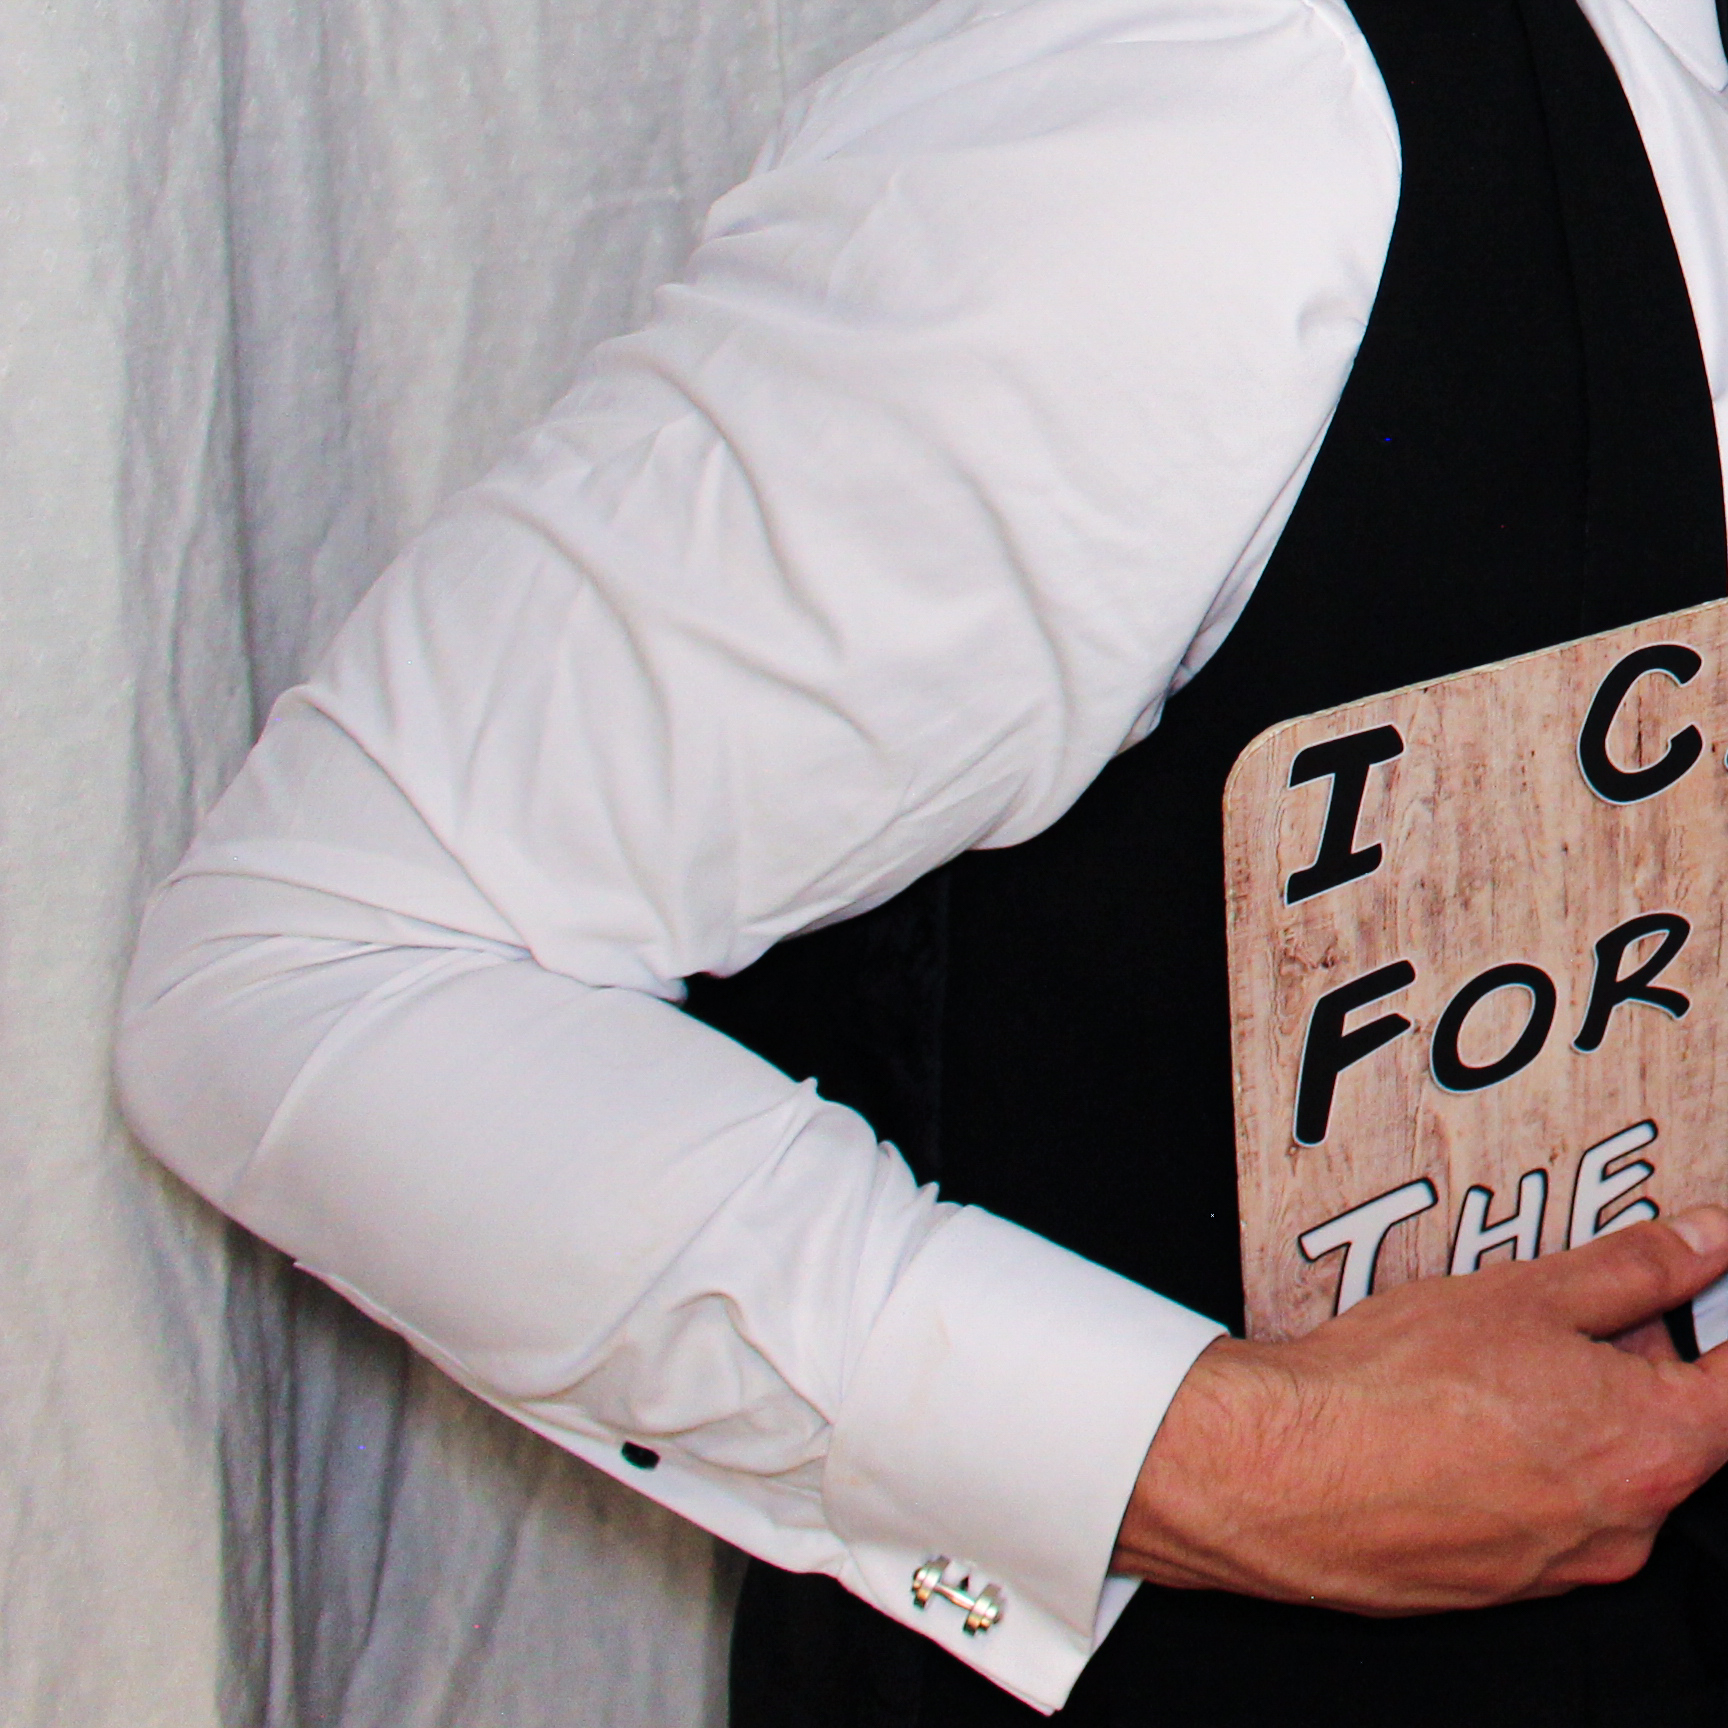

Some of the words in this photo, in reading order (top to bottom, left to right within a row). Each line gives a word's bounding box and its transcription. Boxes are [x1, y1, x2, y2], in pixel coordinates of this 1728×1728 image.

[1284, 724, 1404, 906] I
[1292, 912, 1691, 1147] FOR
[1297, 1119, 1659, 1317] THE
